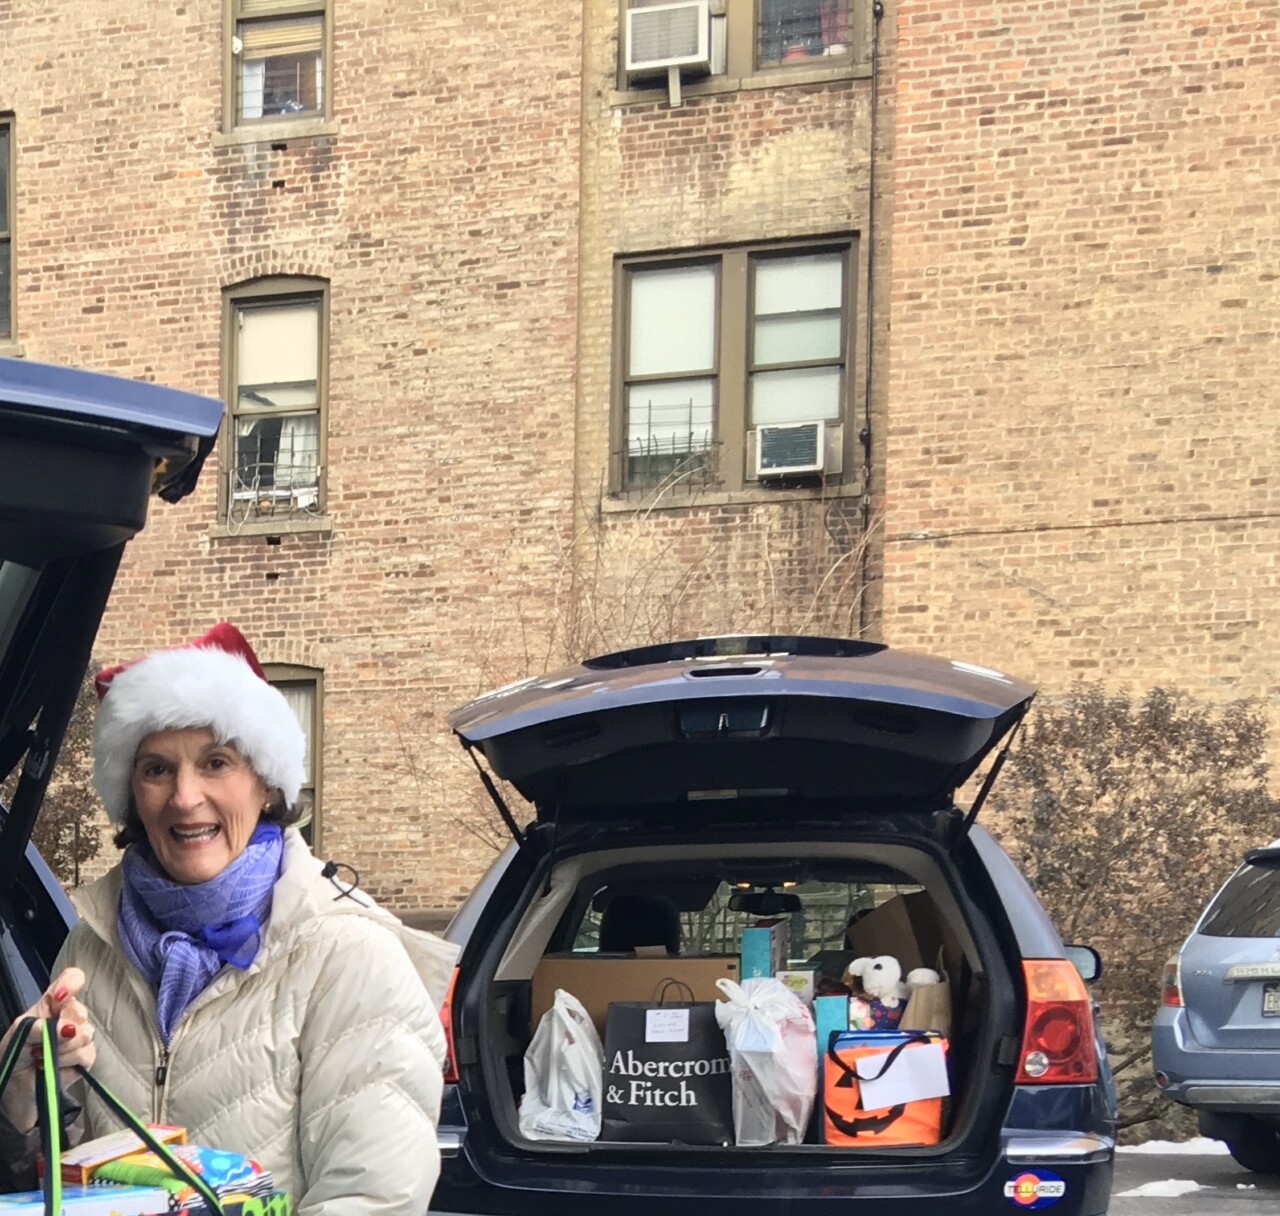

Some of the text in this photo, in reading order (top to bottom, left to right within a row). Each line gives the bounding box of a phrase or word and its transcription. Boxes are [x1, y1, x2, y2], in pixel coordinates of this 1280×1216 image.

[606, 1080, 698, 1106] & Fitch
[1007, 1185, 1062, 1194] TELLURIDE
